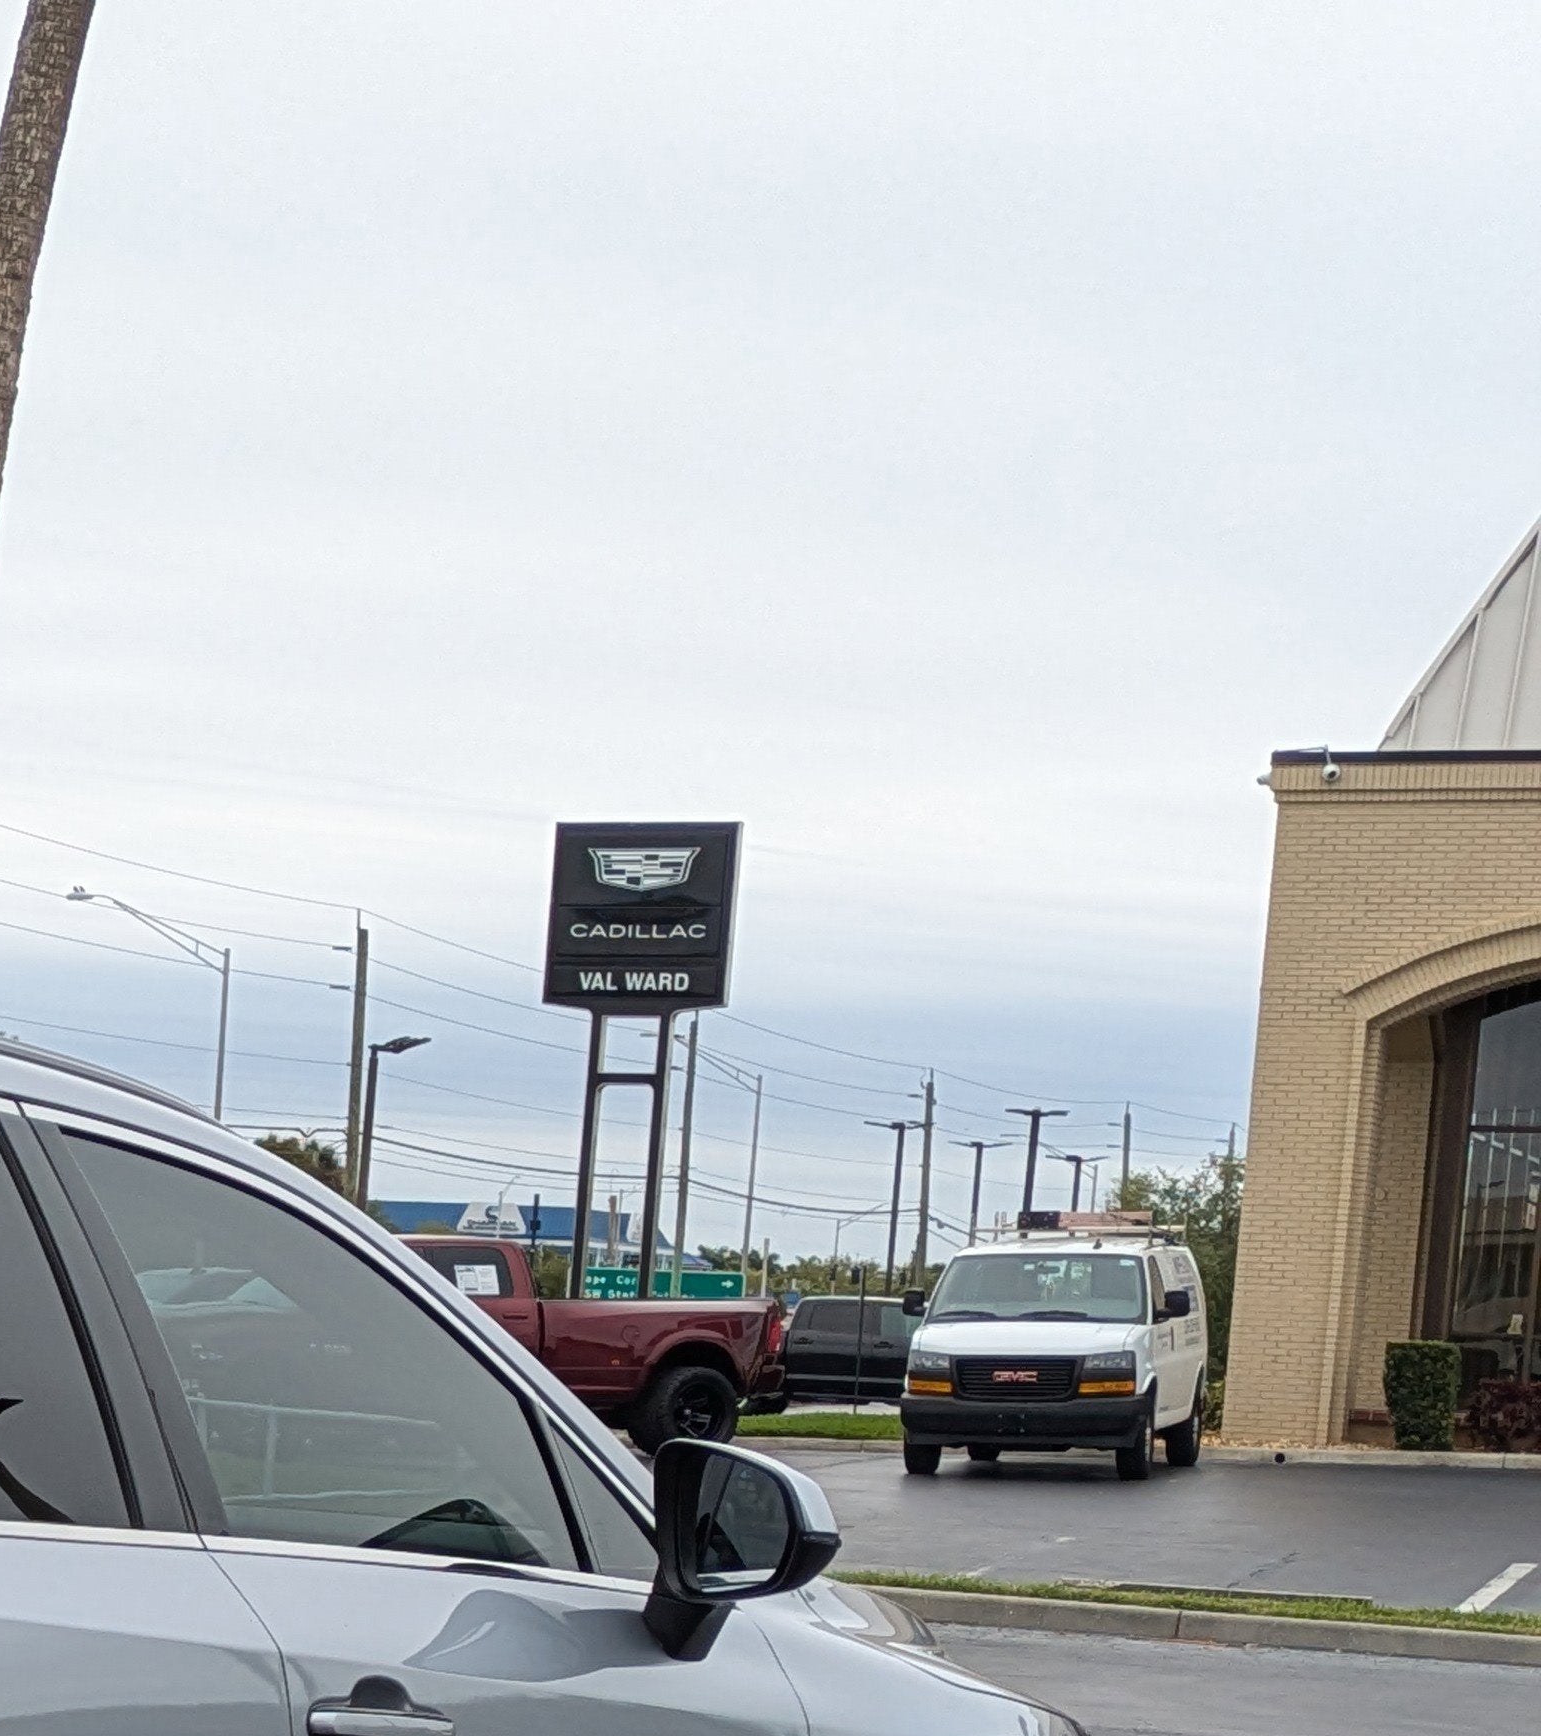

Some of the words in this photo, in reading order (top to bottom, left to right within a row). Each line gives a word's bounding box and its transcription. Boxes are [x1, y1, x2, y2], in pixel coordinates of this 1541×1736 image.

[570, 924, 707, 938] CADILLAC
[579, 972, 618, 990] VAL
[625, 972, 690, 991] WARD
[585, 1275, 606, 1285] ape
[608, 1289, 635, 1299] Stat
[991, 1370, 1038, 1382] GMC
